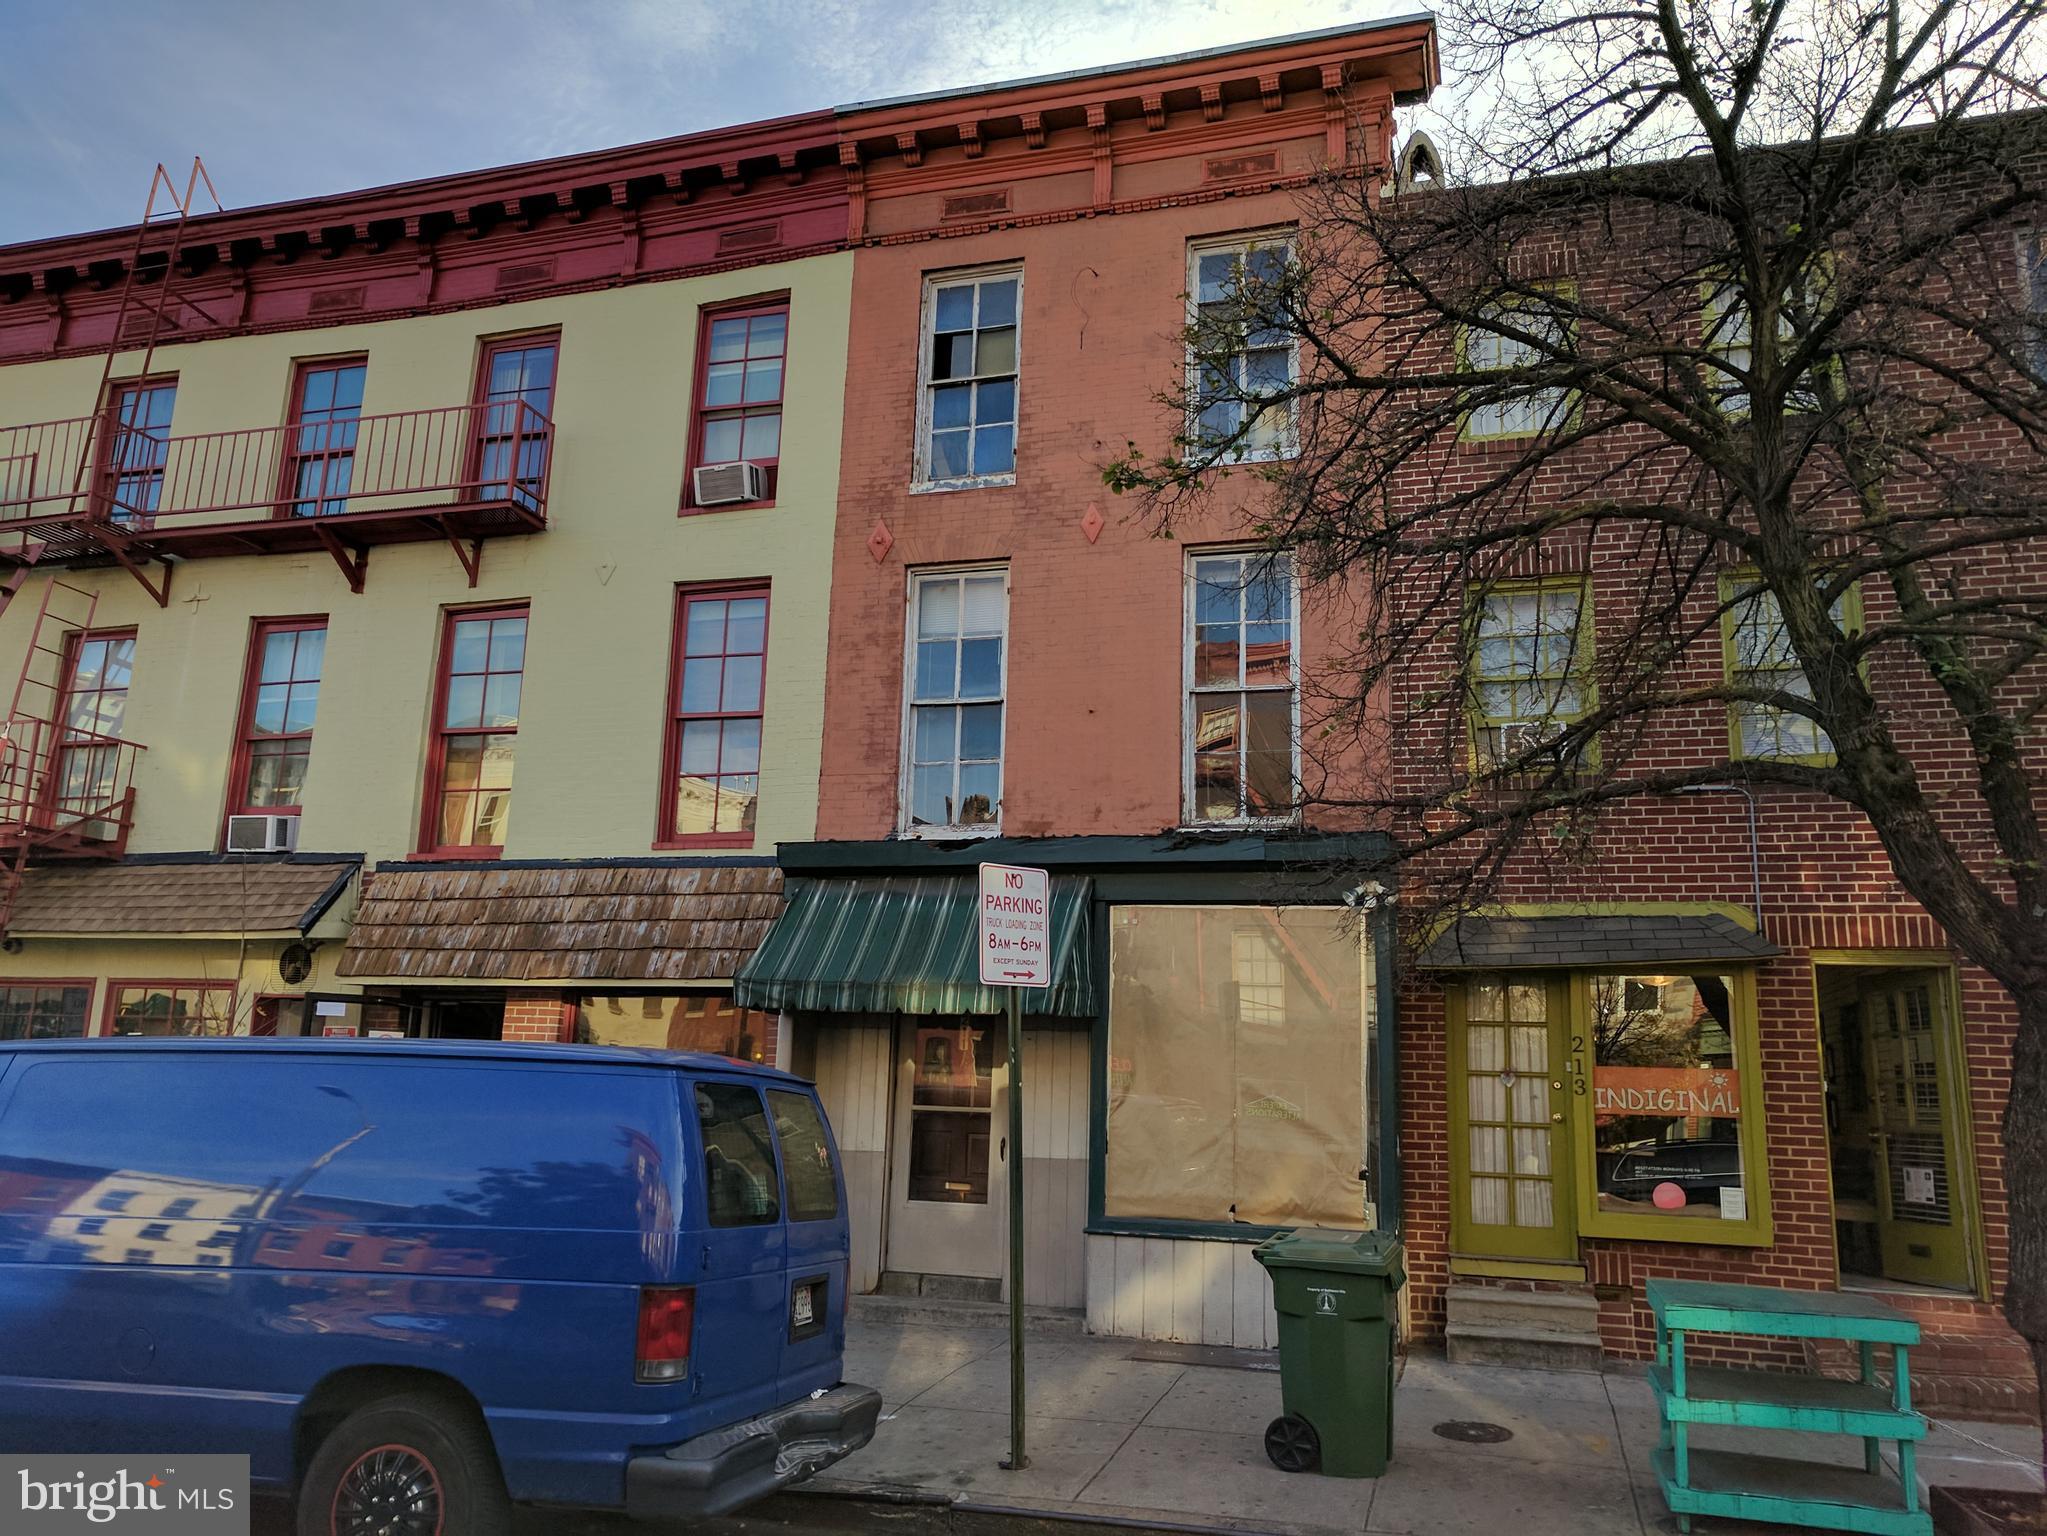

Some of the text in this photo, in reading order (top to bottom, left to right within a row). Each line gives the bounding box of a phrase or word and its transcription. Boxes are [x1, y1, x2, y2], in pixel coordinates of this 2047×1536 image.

[1005, 872, 1024, 889] NO
[986, 894, 1043, 915] PARKING
[986, 917, 1043, 931] TRUCK LOADING ZONE
[993, 957, 1039, 967] EXCEPT SUNDAY
[1594, 1087, 1741, 1114] INDIGINAL
